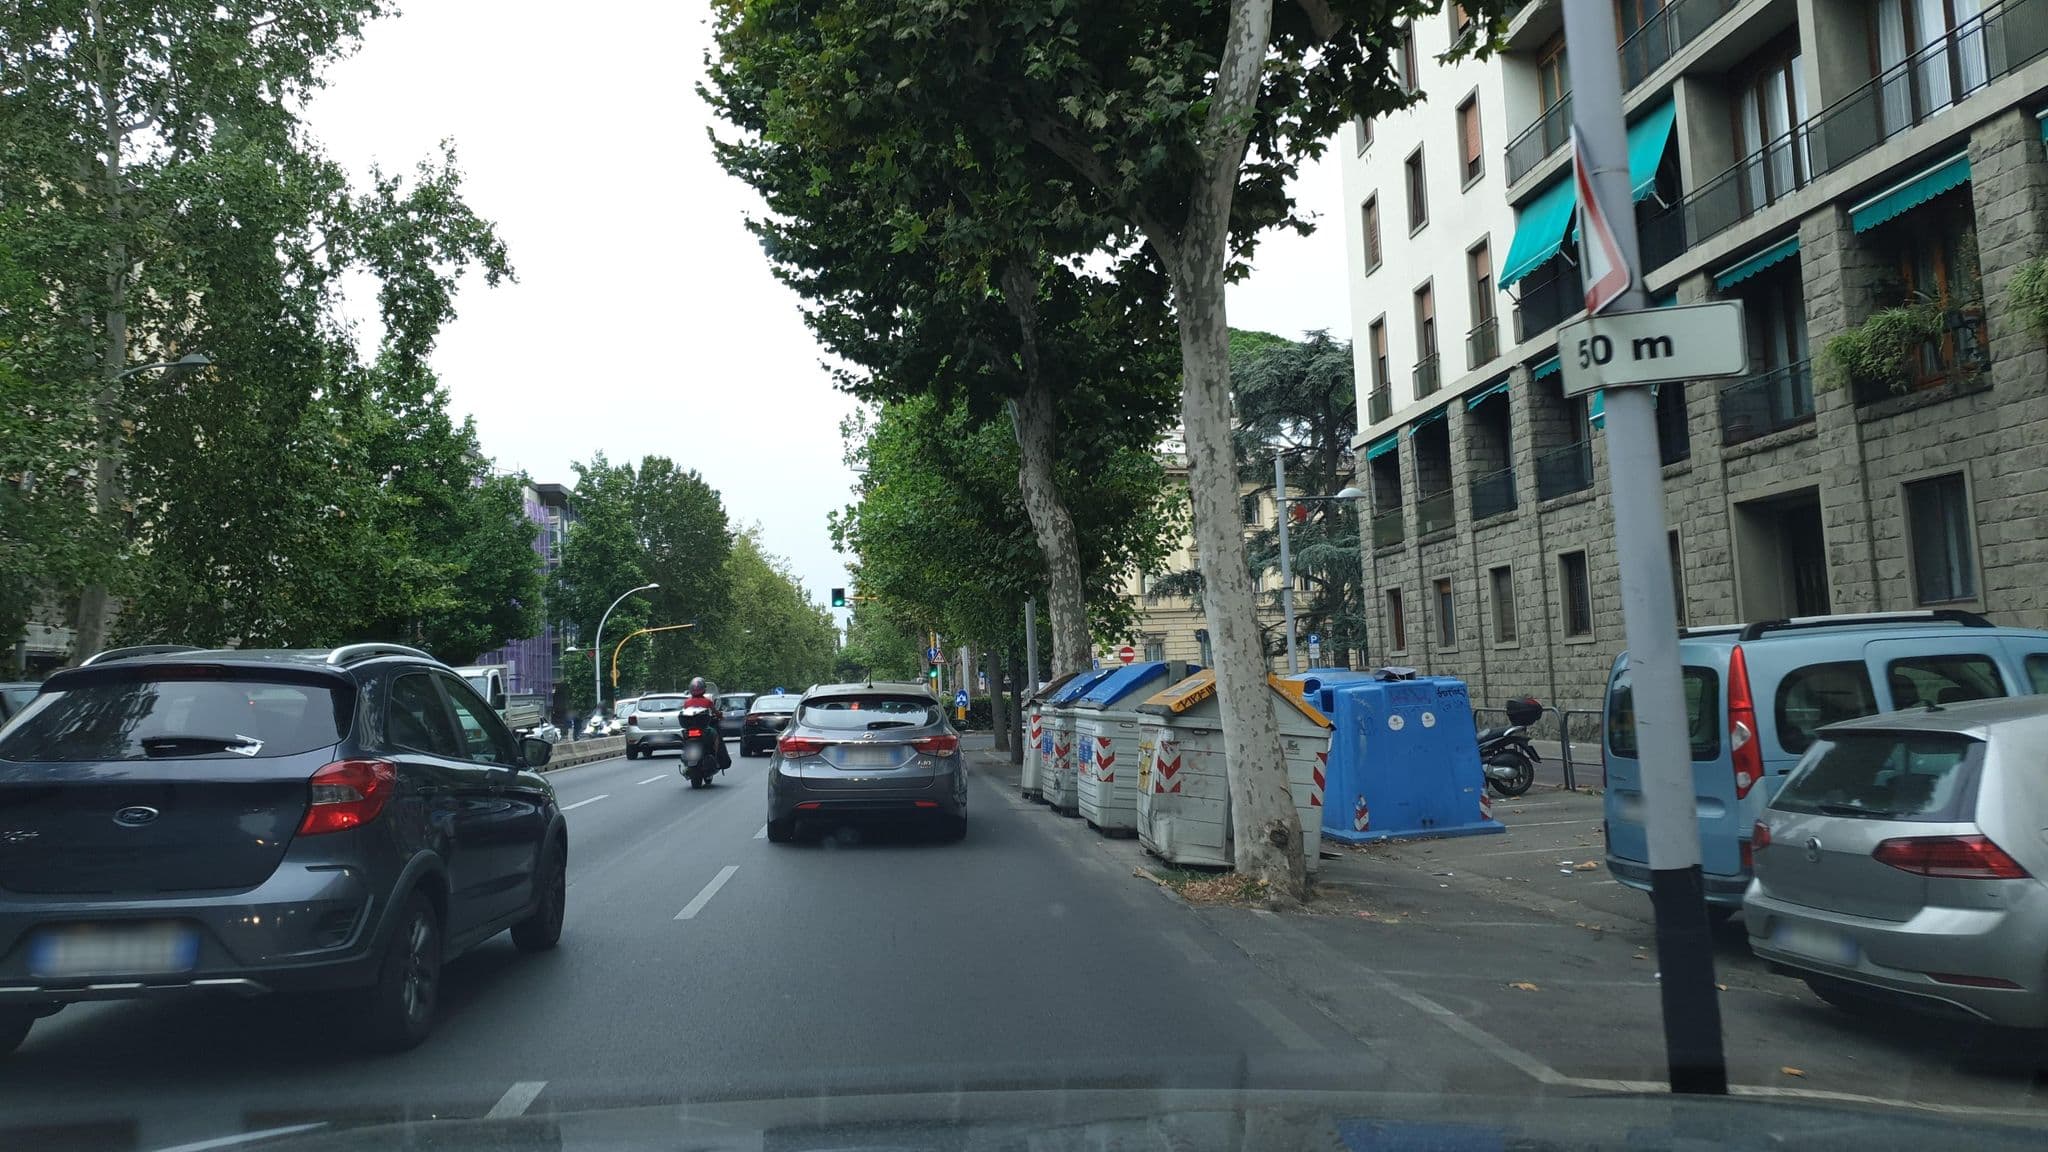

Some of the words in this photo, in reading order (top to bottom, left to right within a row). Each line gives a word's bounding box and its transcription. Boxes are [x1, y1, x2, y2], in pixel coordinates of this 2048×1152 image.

[1578, 334, 1613, 370] 50
[1631, 335, 1675, 361] m
[1310, 635, 1318, 644] P
